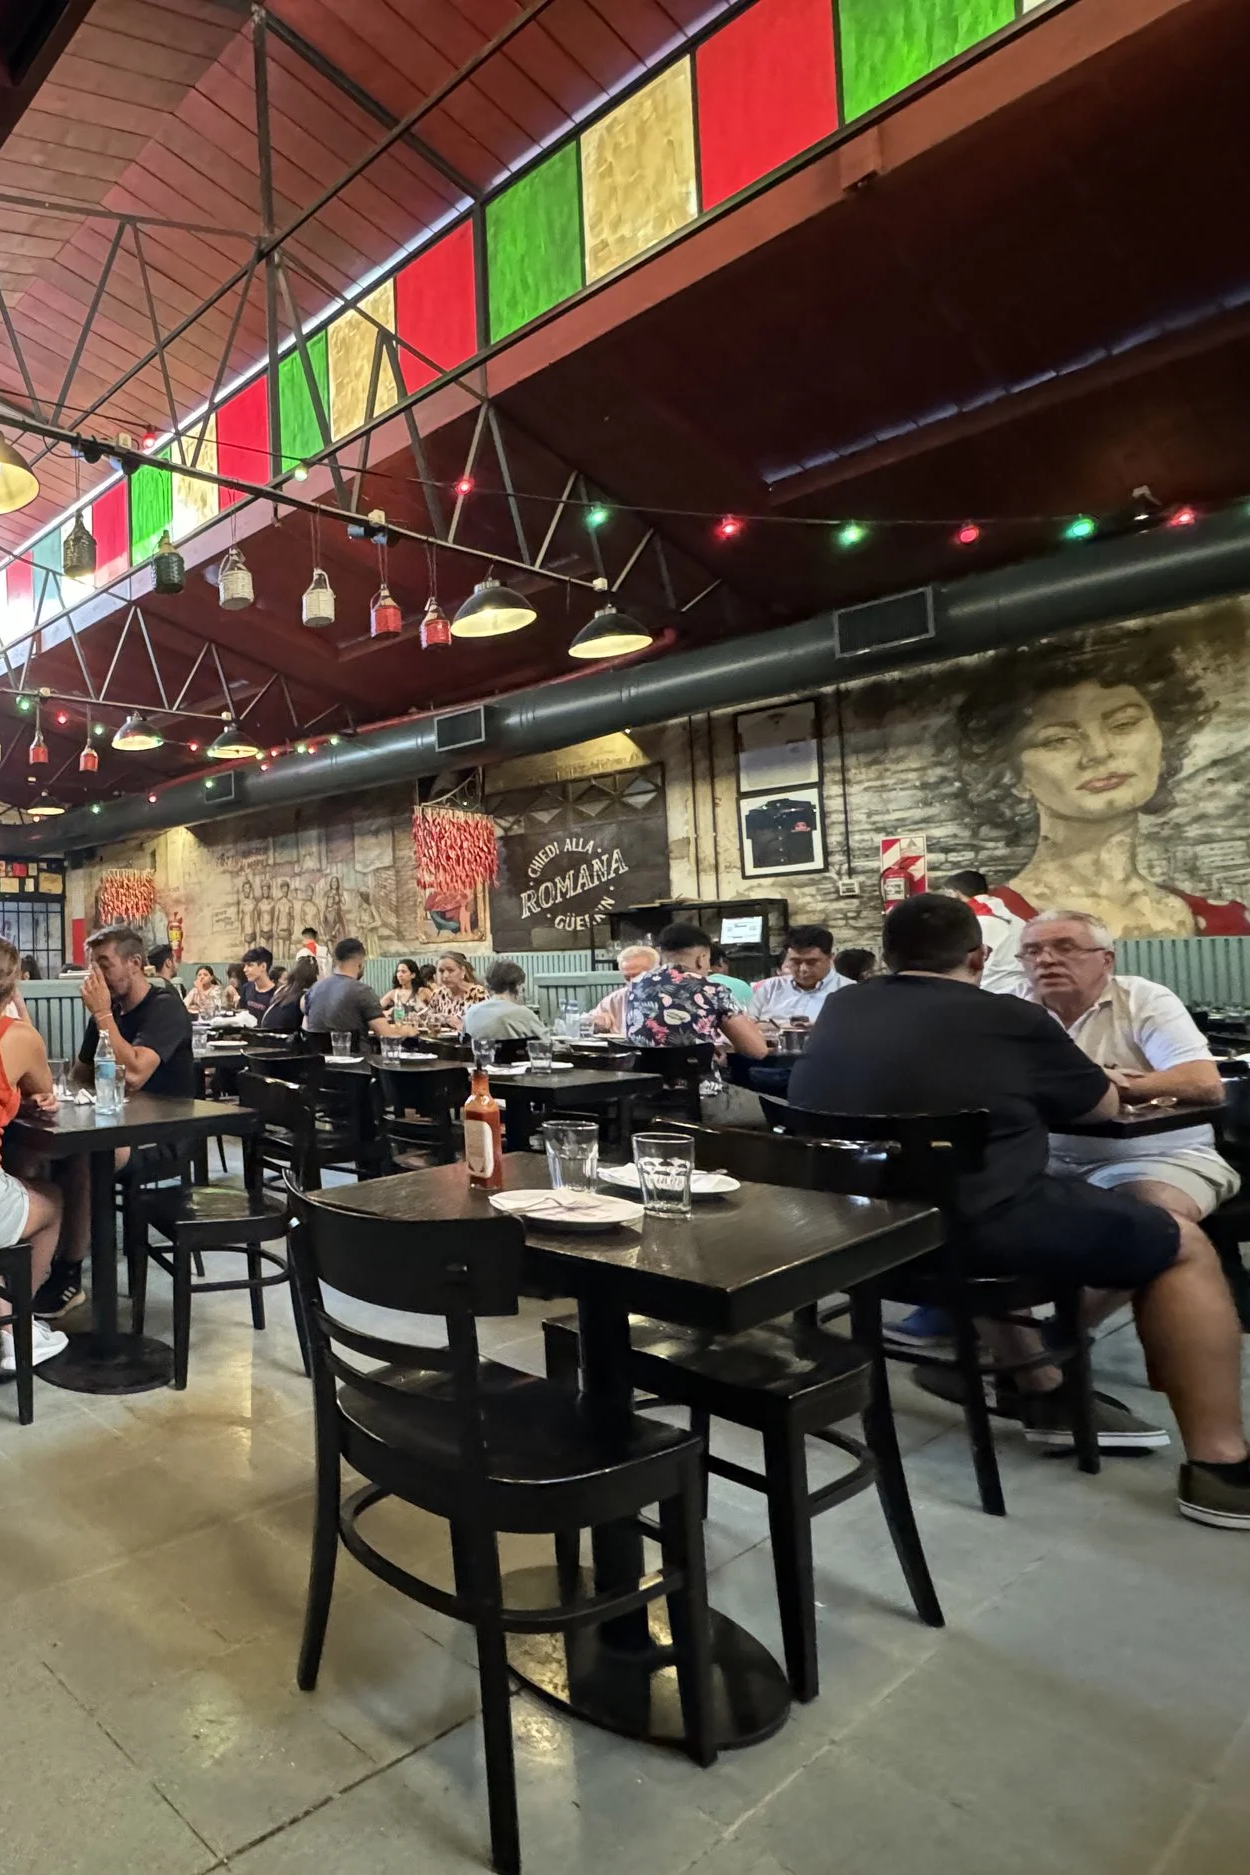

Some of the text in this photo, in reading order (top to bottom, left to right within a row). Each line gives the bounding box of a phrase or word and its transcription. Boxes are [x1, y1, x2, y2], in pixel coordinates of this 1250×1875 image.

[520, 848, 629, 919] ROMANA
[528, 838, 594, 878] CHIEDI ALLA
